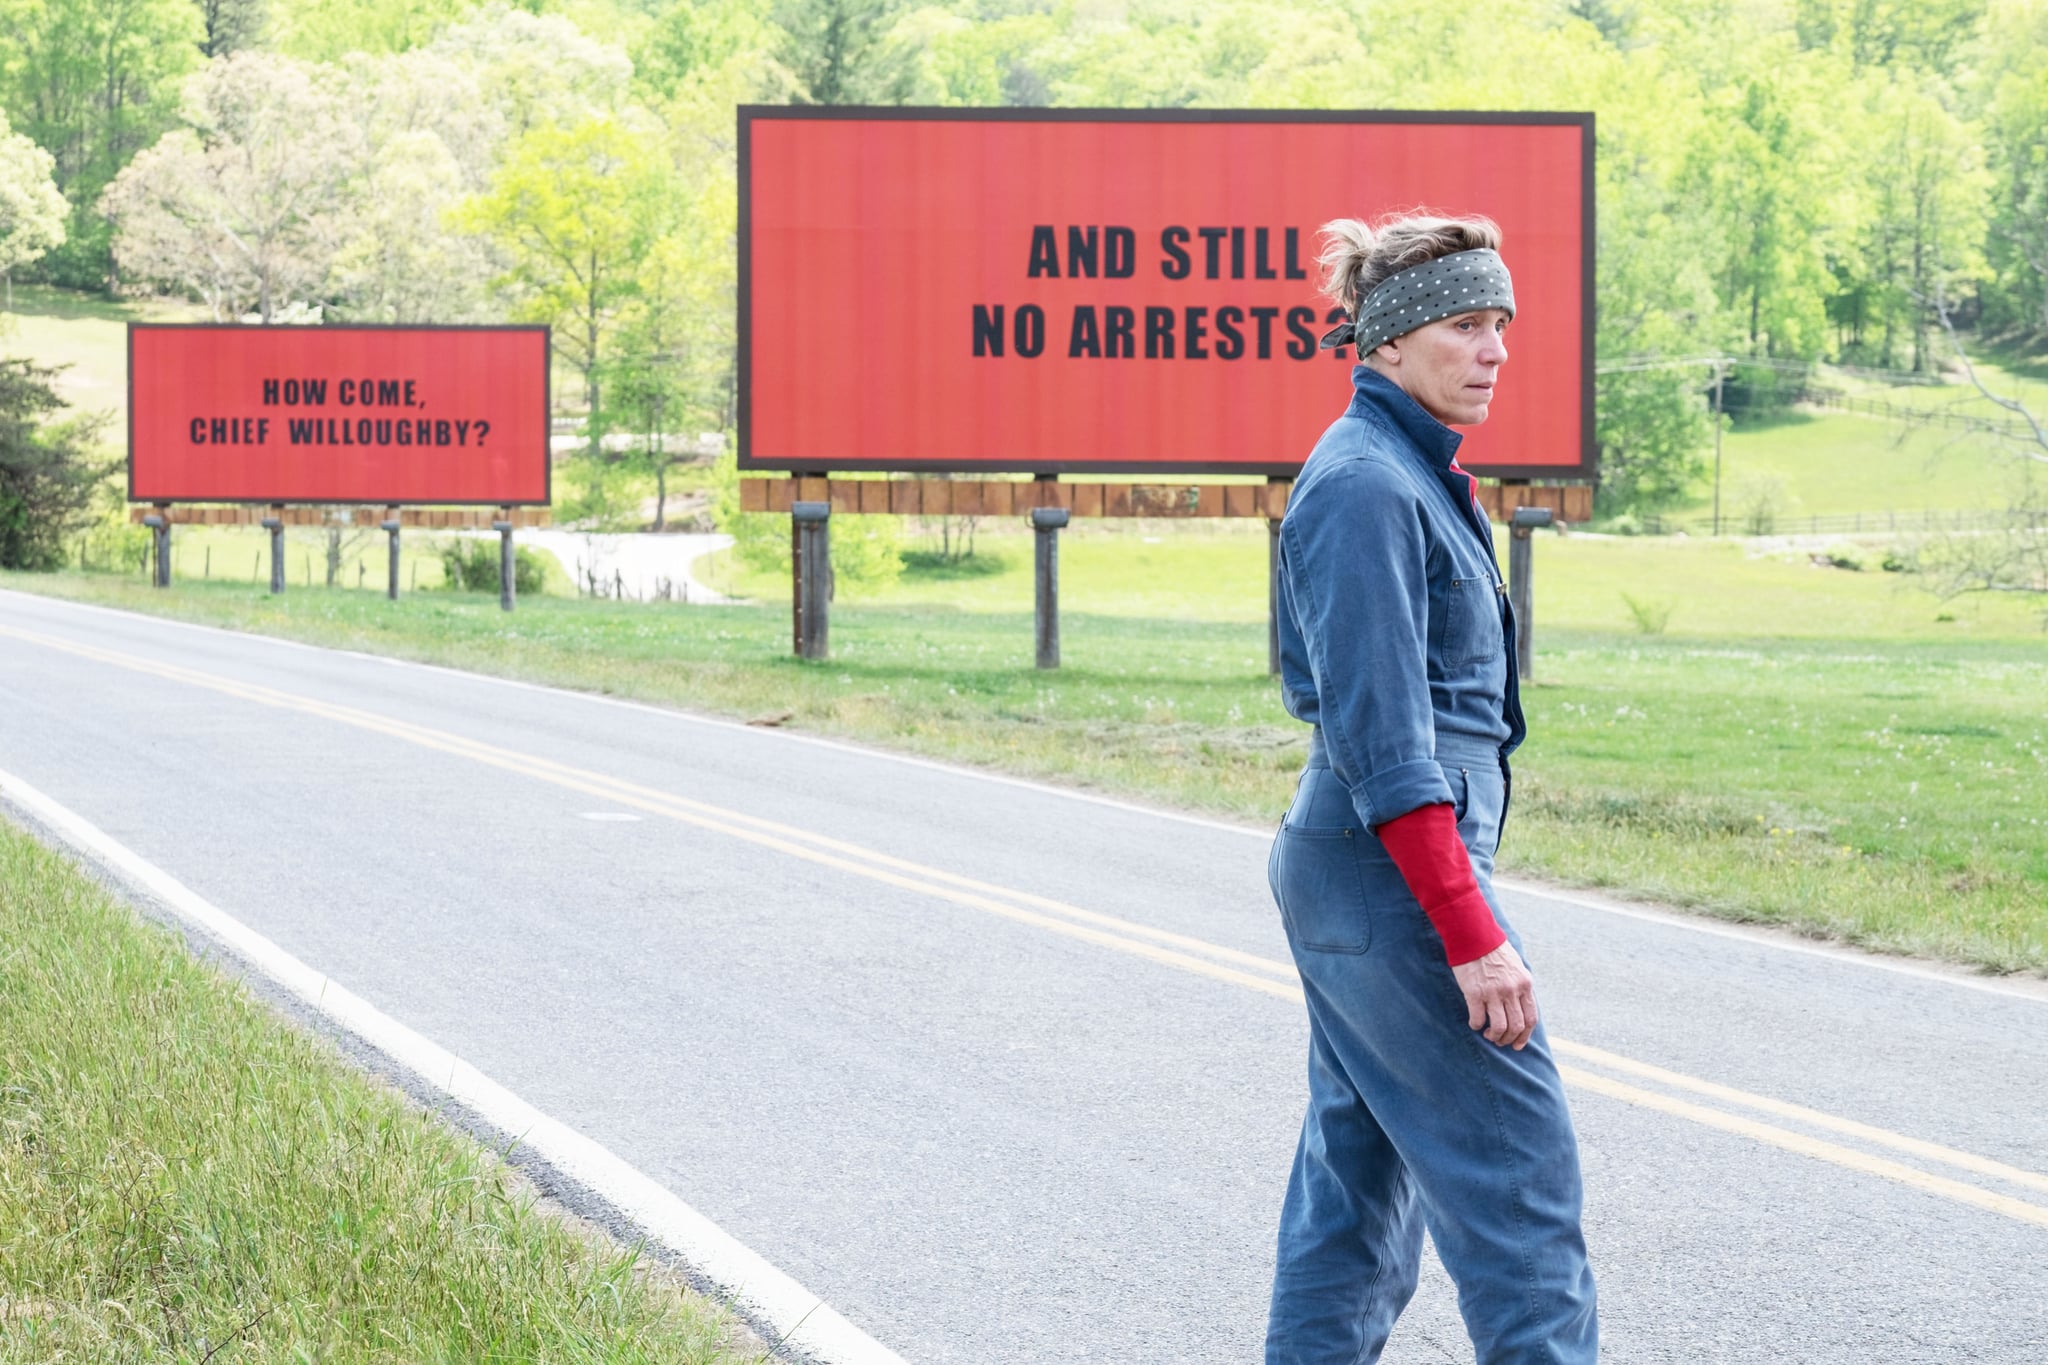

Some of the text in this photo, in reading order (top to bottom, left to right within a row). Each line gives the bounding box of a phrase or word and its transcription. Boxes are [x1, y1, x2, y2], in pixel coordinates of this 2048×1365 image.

[1027, 225, 1307, 281] AND STILL
[972, 304, 1046, 359] NO
[263, 378, 426, 409] HOW COME,
[190, 417, 491, 447] CHIEF WILLOUGHBY?
